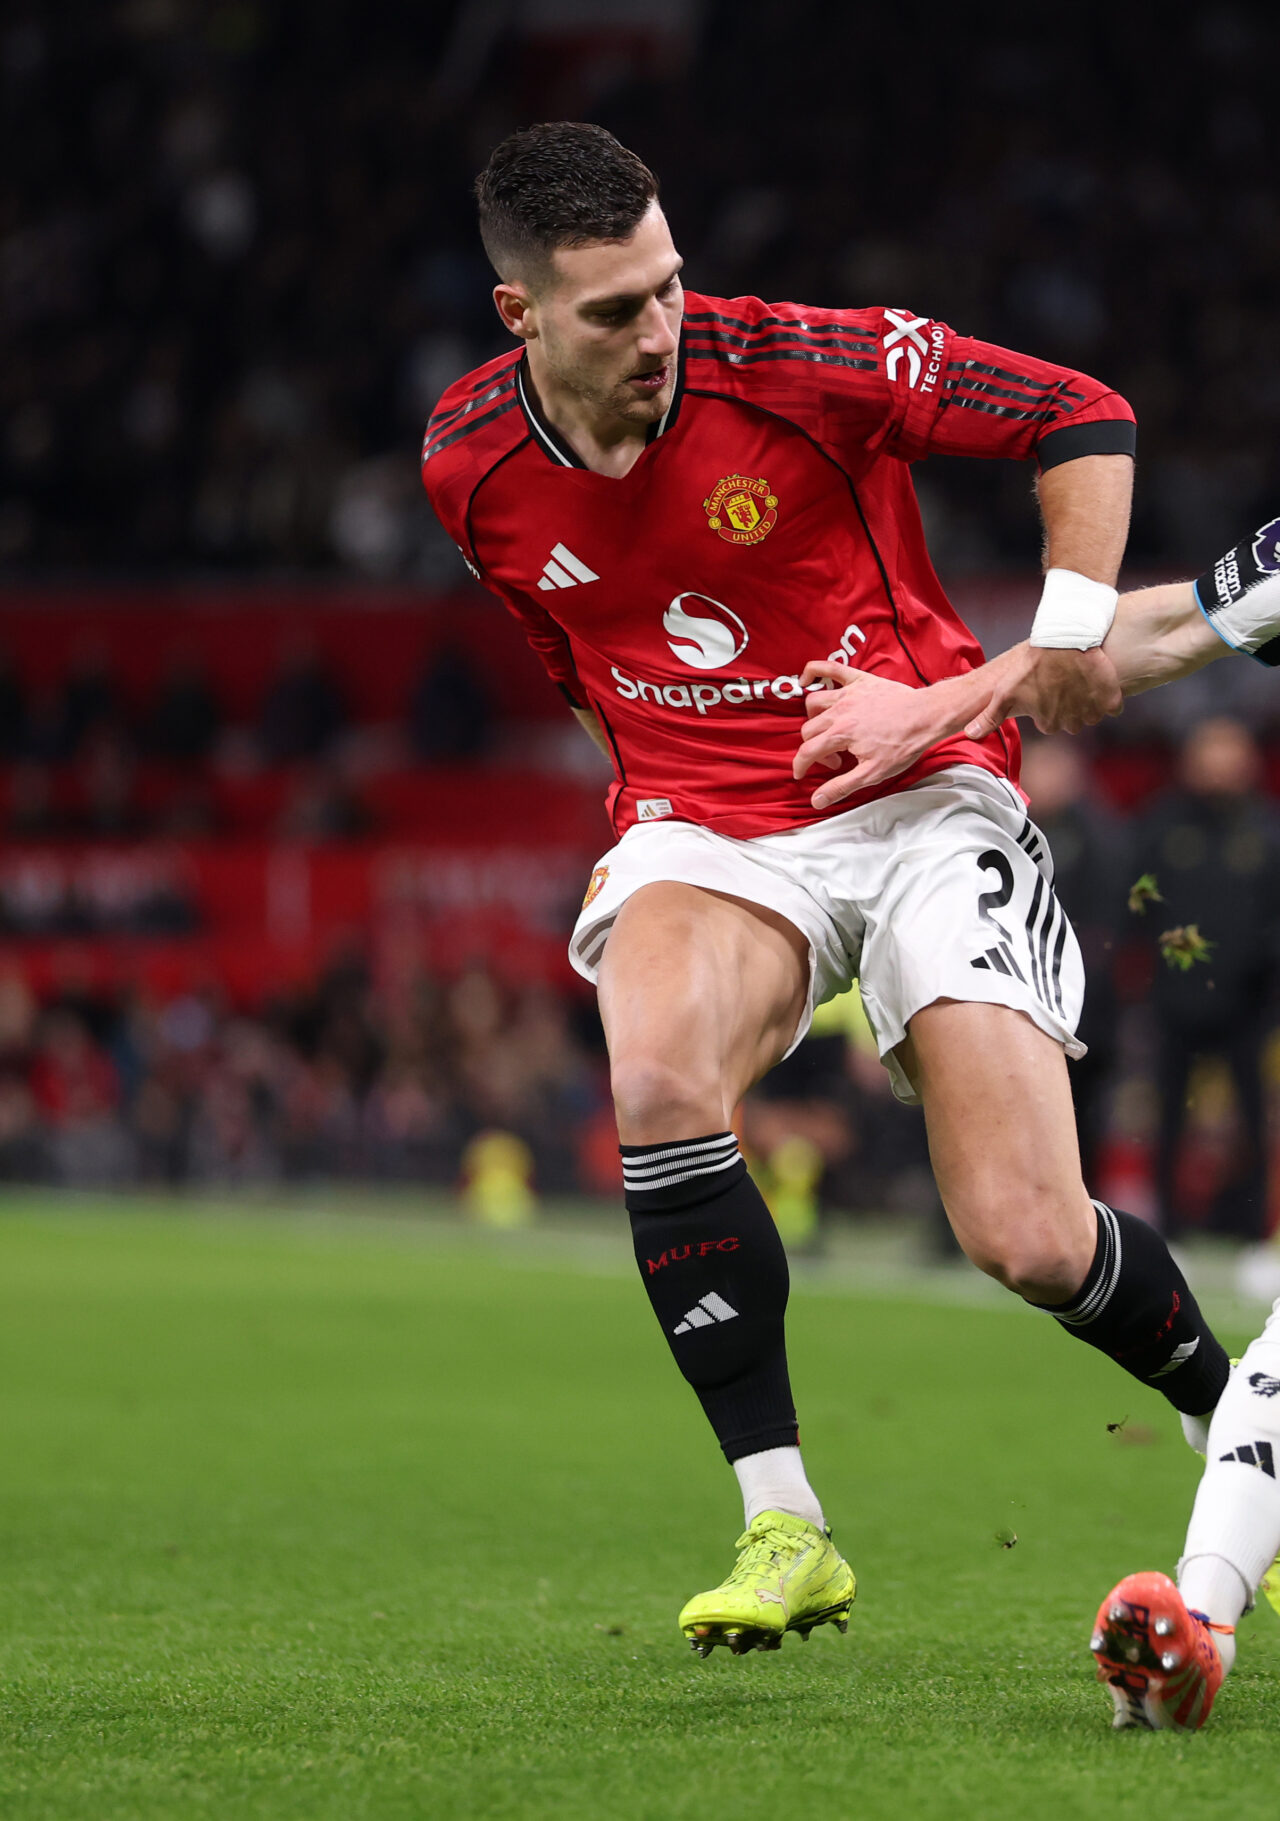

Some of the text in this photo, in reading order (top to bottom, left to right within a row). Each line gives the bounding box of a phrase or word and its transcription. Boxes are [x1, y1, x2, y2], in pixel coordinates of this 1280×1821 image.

[883, 308, 930, 389] DX
[709, 479, 765, 511] MANCHESTER
[732, 521, 771, 542] UNITED
[1225, 560, 1242, 595] room
[976, 849, 1015, 946] 2
